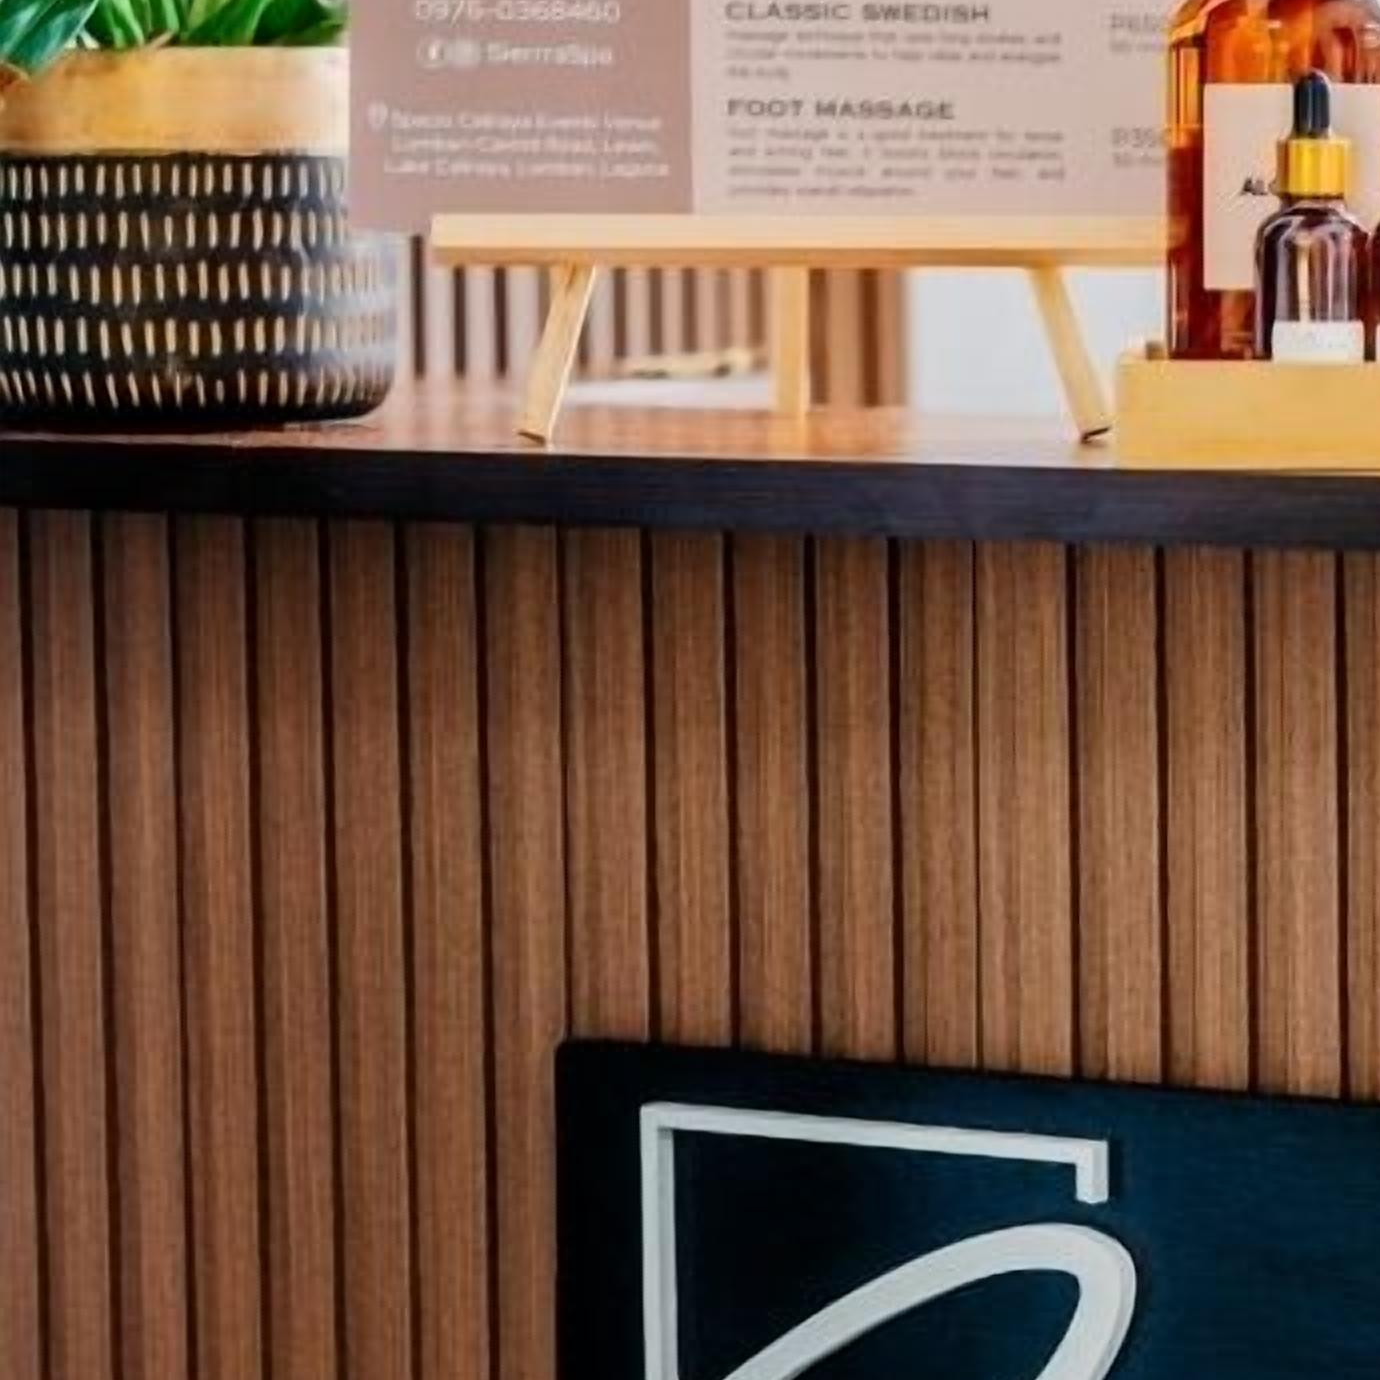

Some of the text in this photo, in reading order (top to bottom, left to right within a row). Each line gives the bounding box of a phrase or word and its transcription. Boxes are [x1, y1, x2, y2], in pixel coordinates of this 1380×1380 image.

[724, 0, 990, 24] CLASSIC SWEDISH
[726, 98, 956, 121] FOOT MASSAGE
